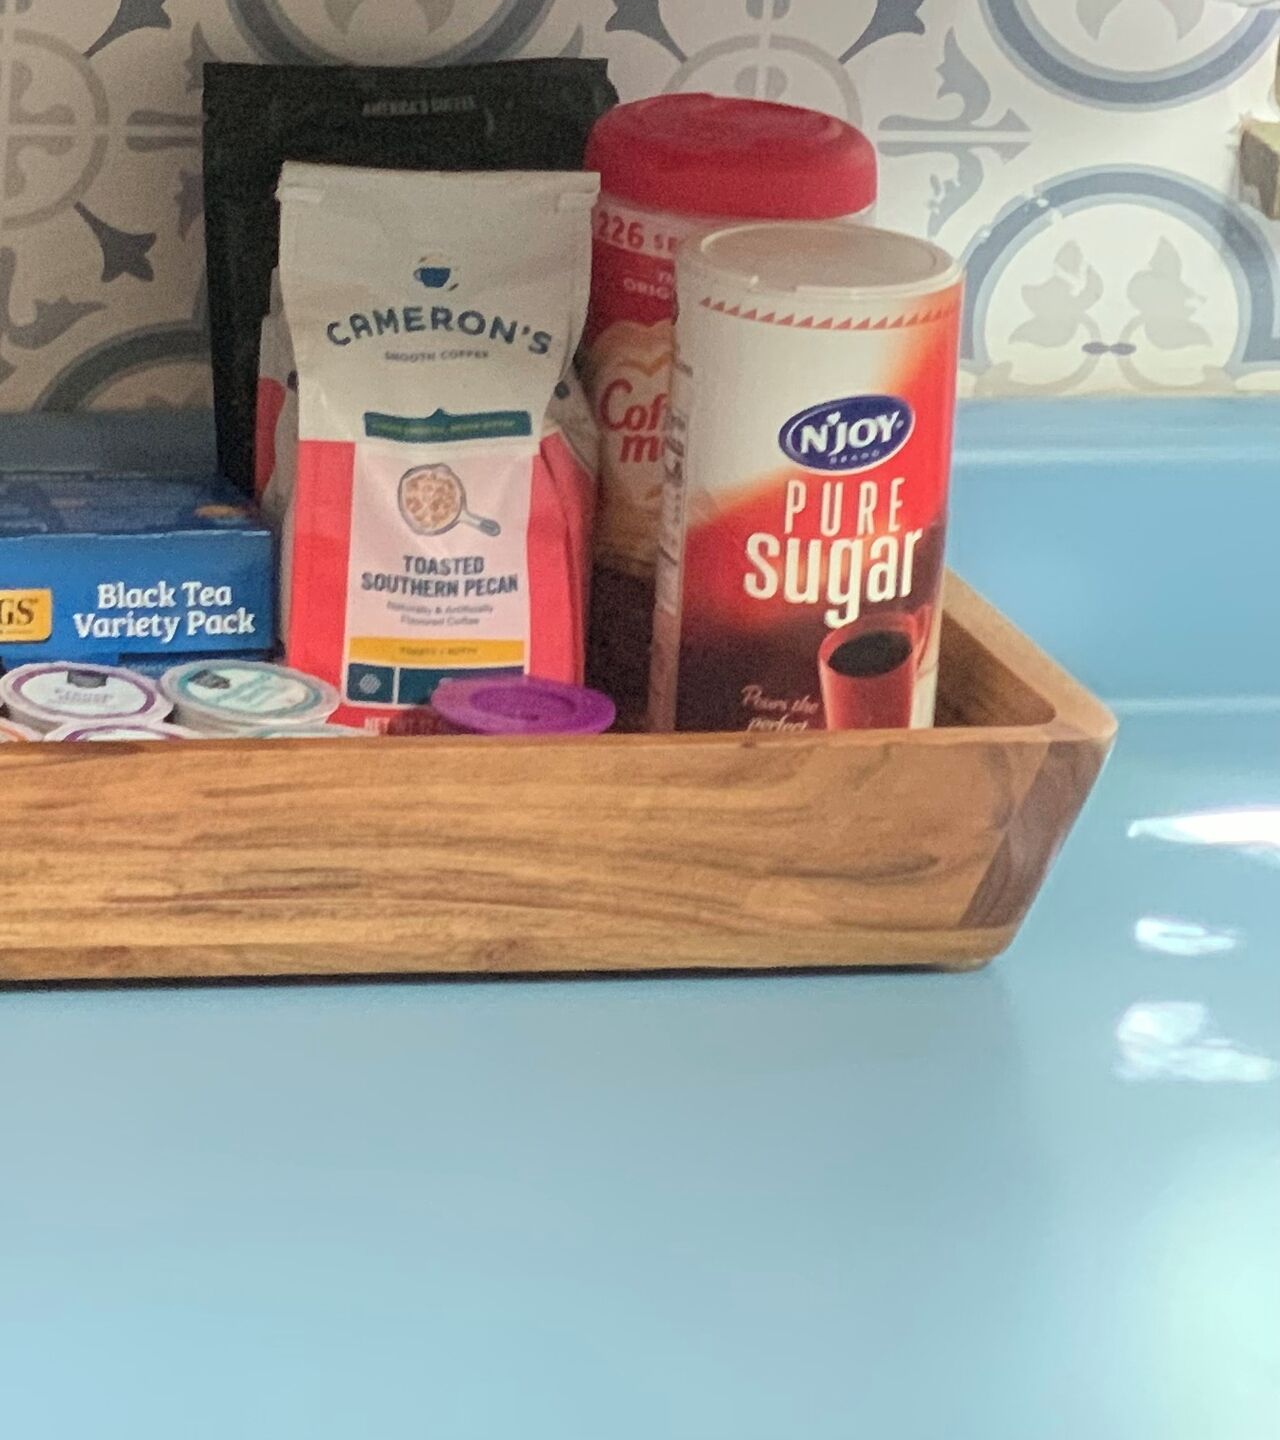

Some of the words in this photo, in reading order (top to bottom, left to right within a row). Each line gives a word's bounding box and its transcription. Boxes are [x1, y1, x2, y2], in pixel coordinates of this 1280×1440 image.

[598, 211, 645, 250] 226
[326, 306, 552, 356] CAMERON'S
[784, 476, 906, 537] PURE
[403, 554, 485, 576] TOASTED
[743, 527, 924, 629] sugar
[97, 581, 175, 611] Black
[180, 581, 232, 607] Tea
[361, 571, 458, 598] SOUTHERN
[463, 573, 519, 597] PECAN
[72, 610, 179, 645] Variety
[186, 607, 256, 637] Pack
